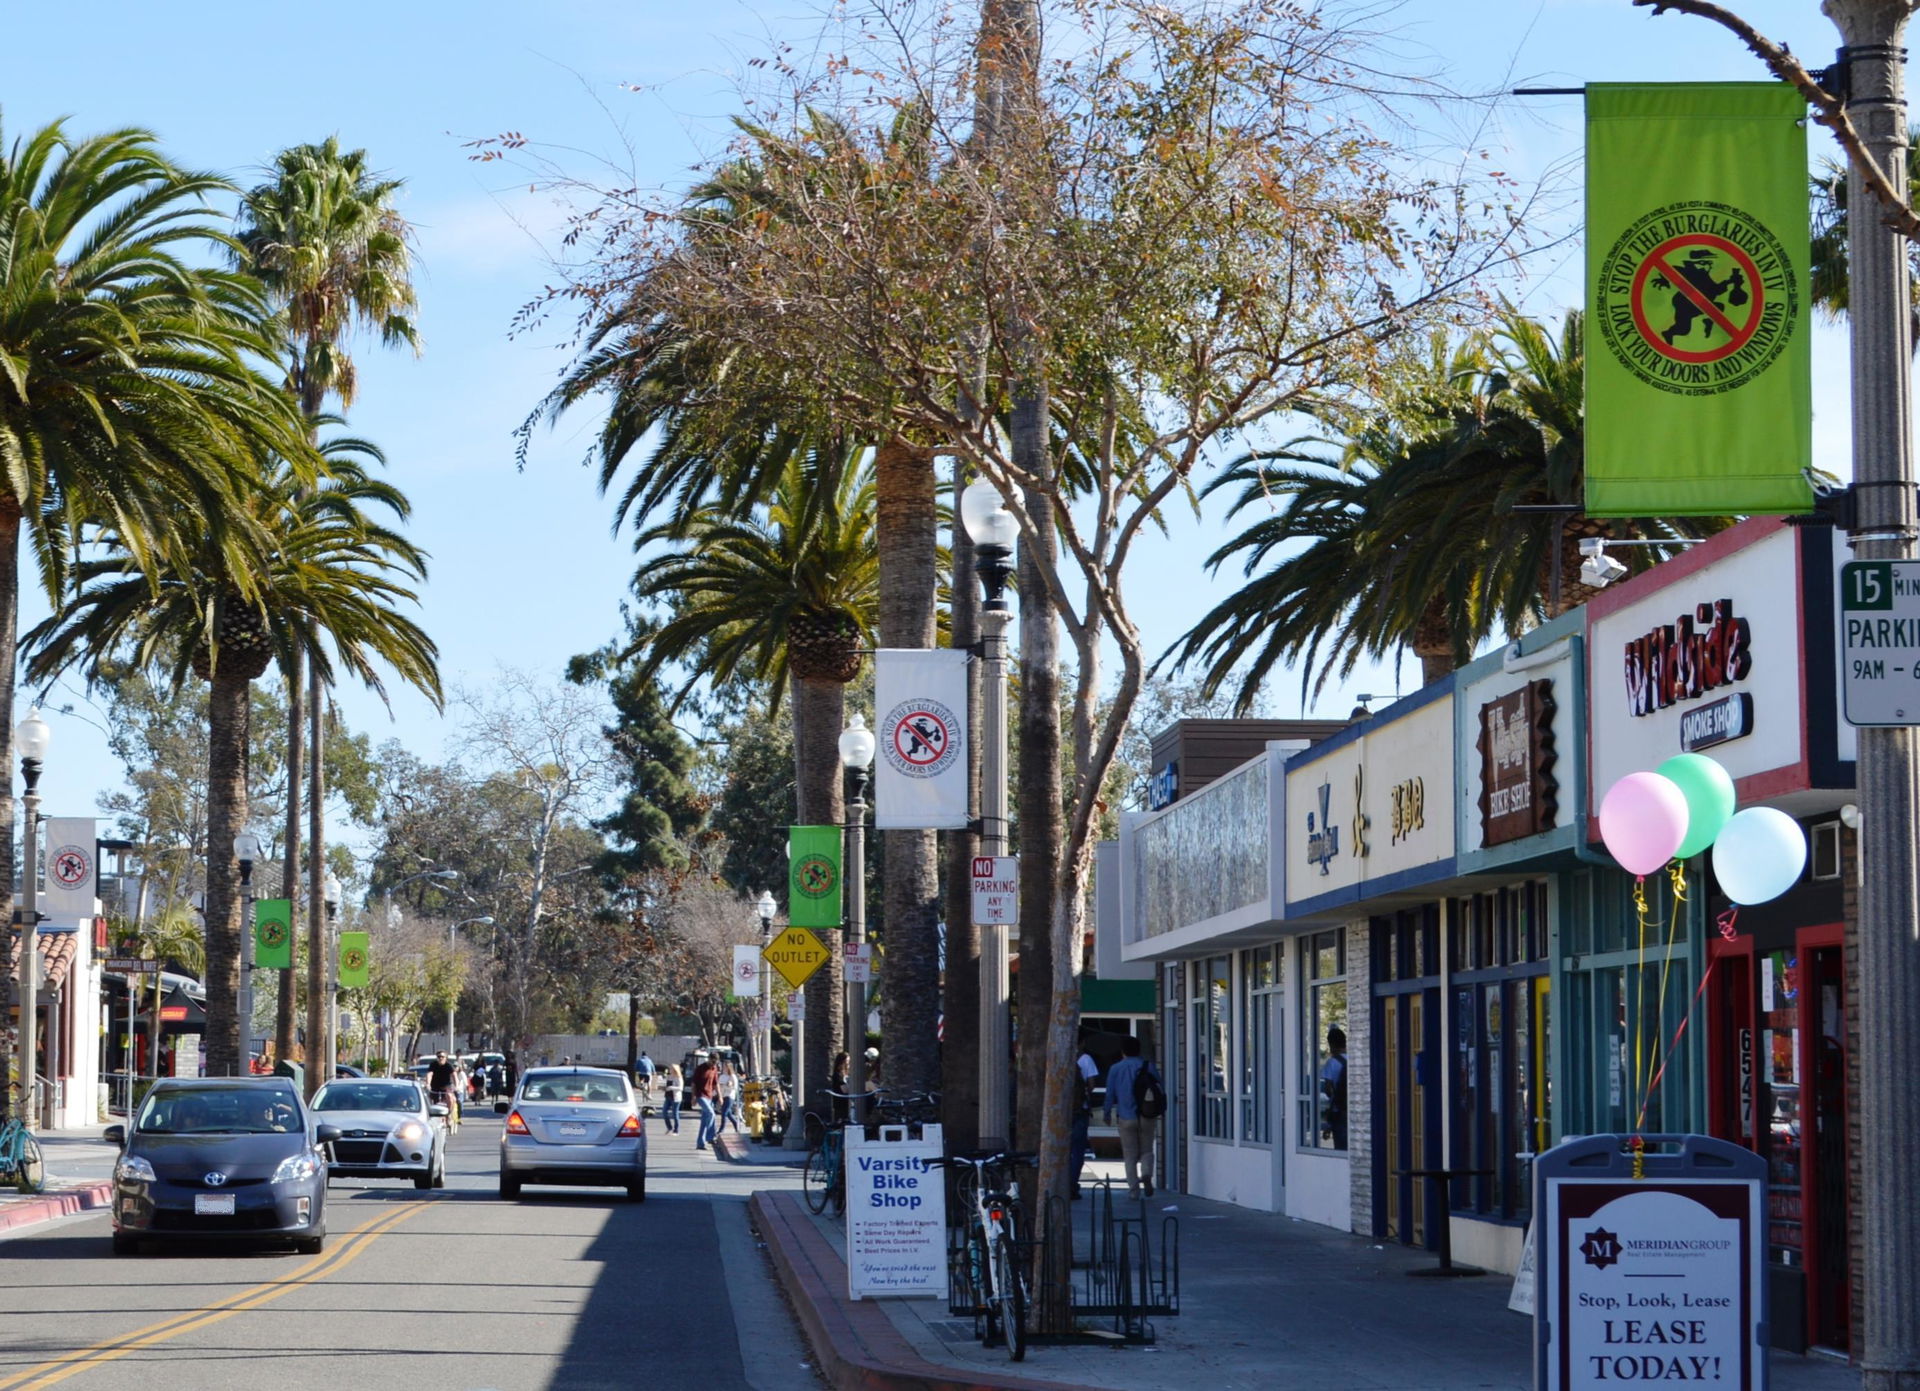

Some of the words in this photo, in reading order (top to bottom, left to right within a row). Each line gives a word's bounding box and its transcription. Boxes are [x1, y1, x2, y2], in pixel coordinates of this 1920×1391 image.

[1628, 225, 1663, 256] THE
[1662, 214, 1766, 257] BURGLARIES
[1756, 251, 1779, 274] IN
[1609, 253, 1637, 294] STOP
[1764, 273, 1785, 291] IV
[1610, 304, 1638, 342] LOCK
[1626, 336, 1663, 373] YOUR
[1660, 358, 1710, 384] DOORS
[1713, 356, 1742, 382] AND
[1735, 302, 1785, 365] WINDOWS
[1853, 569, 1881, 603] 15
[1848, 619, 1920, 648] PARKI
[1853, 660, 1885, 680] 9AM
[1683, 707, 1714, 742] SMOKE
[1713, 700, 1739, 735] SHOP
[1391, 776, 1424, 847] BBQ
[1490, 788, 1510, 820] BIKE
[975, 860, 991, 876] NO
[975, 880, 1016, 894] PARKING
[987, 897, 1003, 907] ANY
[987, 908, 1003, 919] TIME
[787, 934, 805, 945] NO
[846, 943, 857, 954] NO
[771, 951, 821, 963] OUTLET
[846, 956, 869, 964] PARKING
[1741, 1029, 1752, 1121] 6547
[858, 1156, 932, 1174] Varsity
[873, 1175, 918, 1189] Bike
[870, 1193, 922, 1210] Shop
[1591, 1240, 1611, 1258] M
[1627, 1240, 1731, 1250] MERIDIANGROUP
[1664, 1251, 1706, 1259] Management
[1578, 1292, 1620, 1310] Stop,
[1627, 1293, 1676, 1309] Look,
[1683, 1293, 1731, 1307] Lease
[1603, 1320, 1707, 1344] LEASE
[1589, 1355, 1721, 1380] TODAY!
